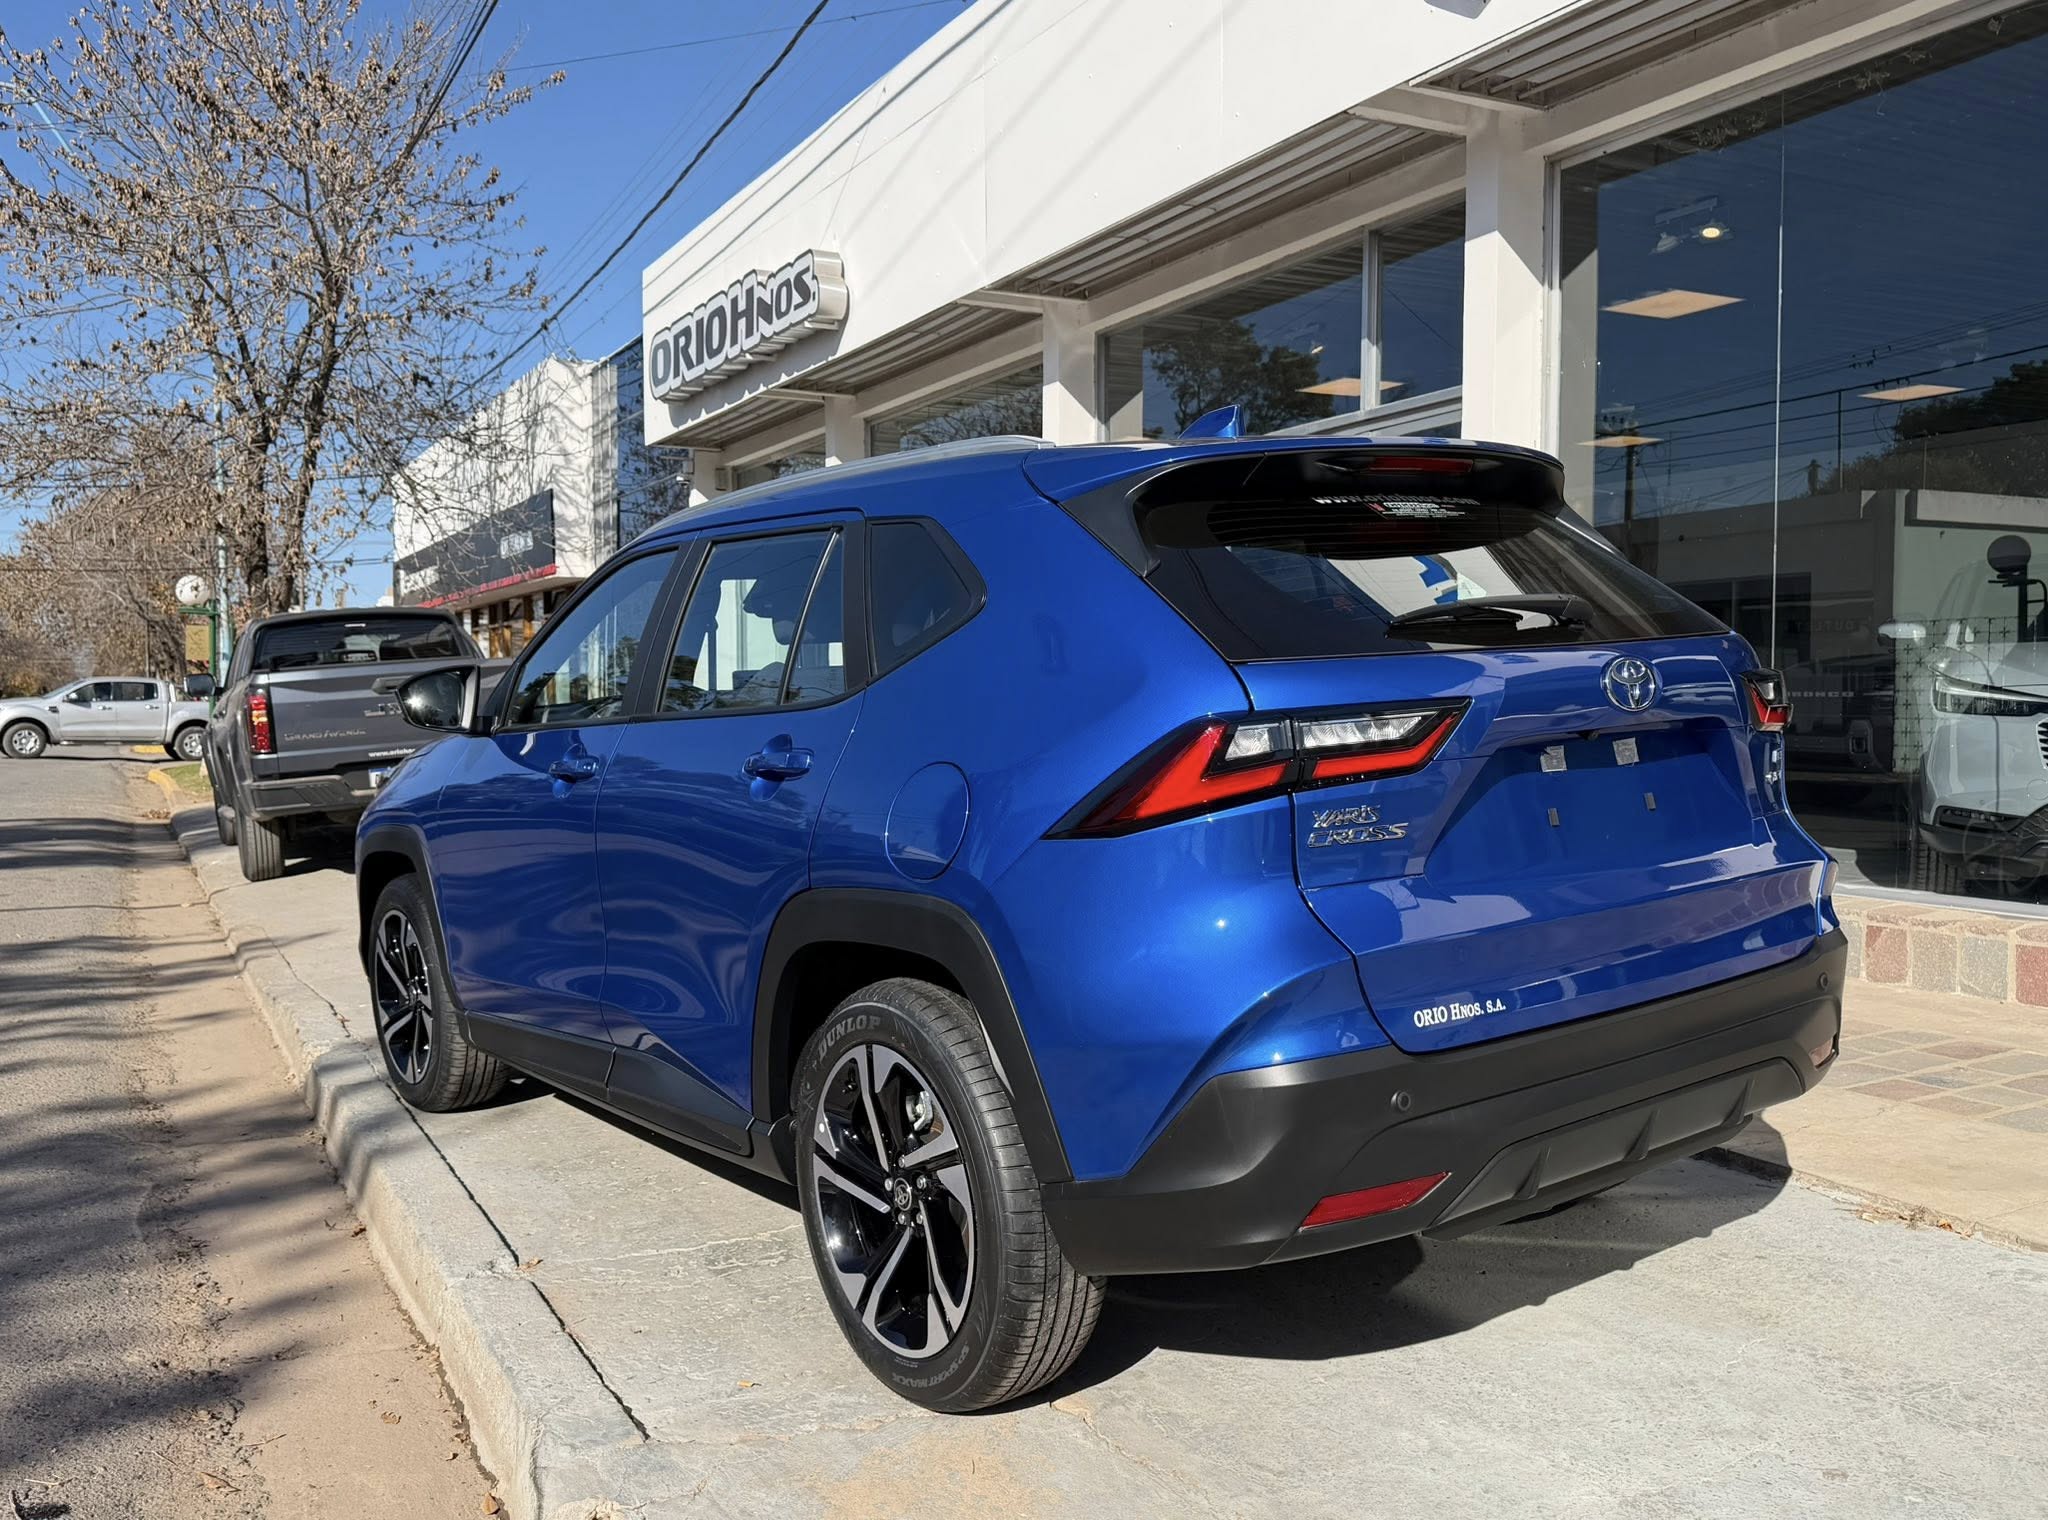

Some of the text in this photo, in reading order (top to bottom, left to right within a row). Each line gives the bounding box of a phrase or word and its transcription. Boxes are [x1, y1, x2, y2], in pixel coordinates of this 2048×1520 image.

[1312, 804, 1380, 828] YARIS
[1307, 822, 1409, 848] CROSS
[1413, 1005, 1448, 1028] ORIO
[1486, 998, 1507, 1014] S.A.
[818, 1014, 881, 1062] DUNLOP
